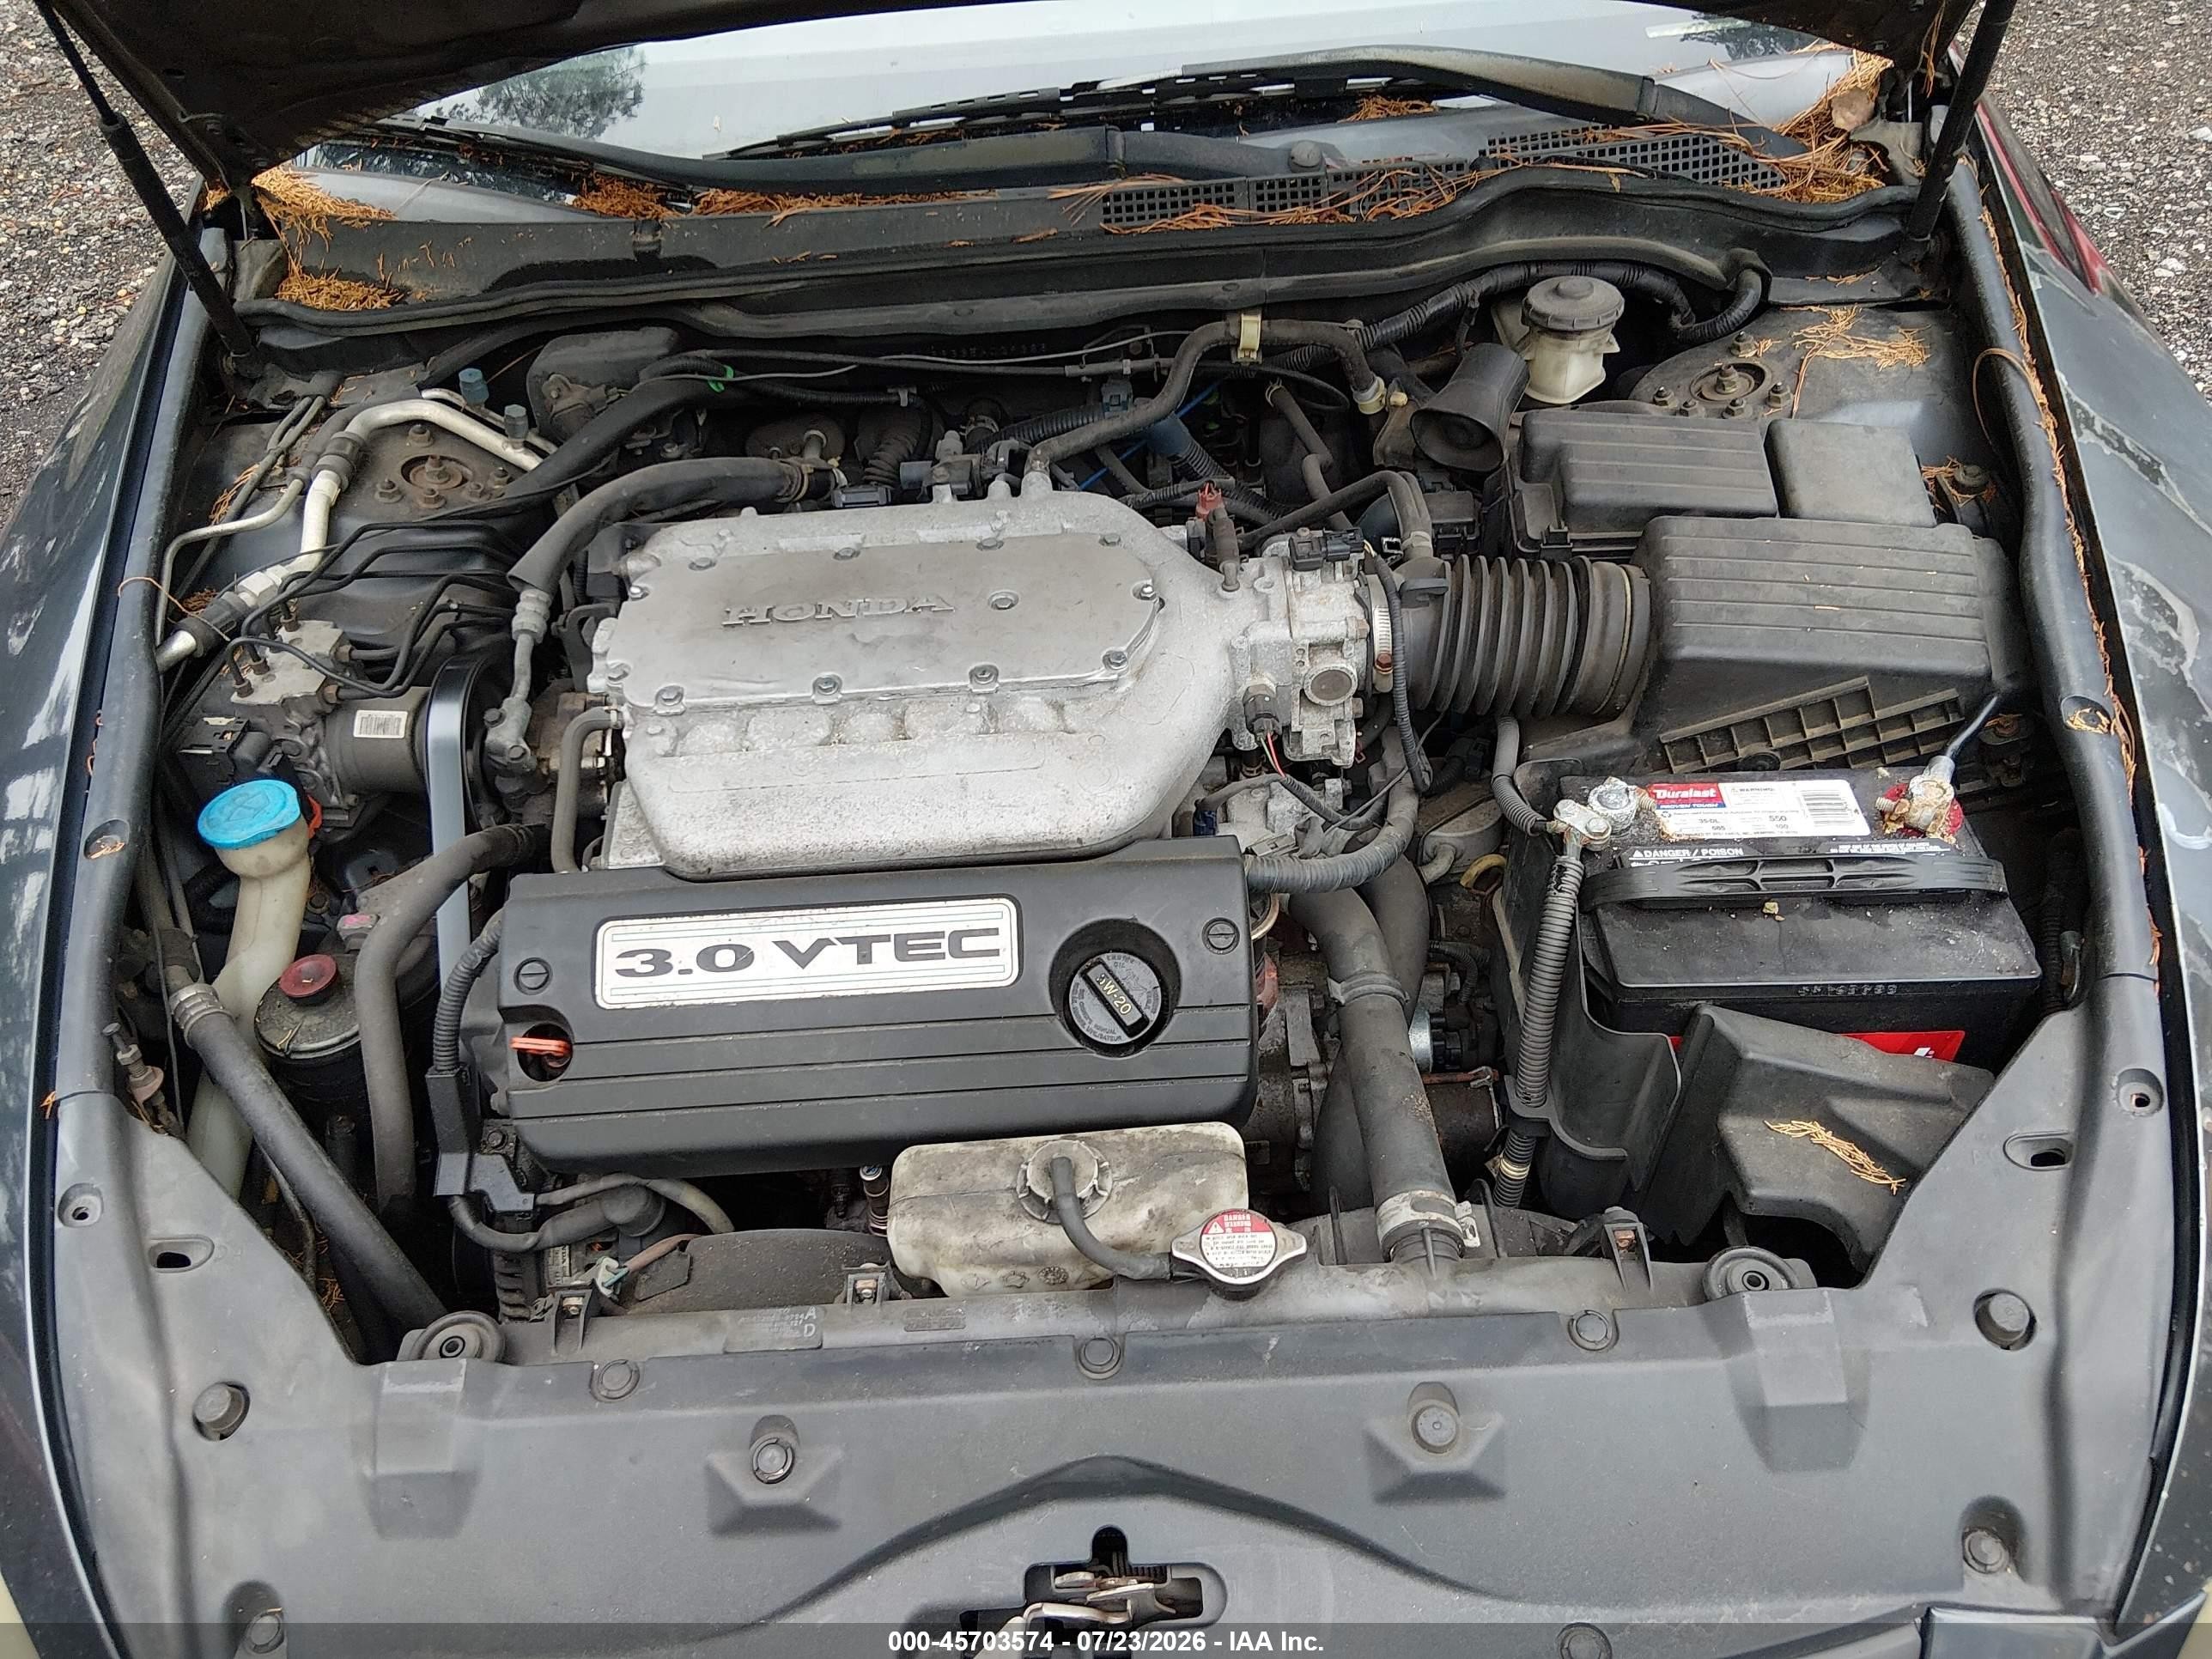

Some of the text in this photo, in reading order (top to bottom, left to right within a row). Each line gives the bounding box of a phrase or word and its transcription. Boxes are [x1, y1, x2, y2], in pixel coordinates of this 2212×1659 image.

[721, 593, 955, 626] HONDA
[1653, 787, 1717, 799] Duralast
[1644, 849, 1691, 858] DANGER
[1701, 848, 1744, 857] POISON
[616, 927, 1000, 978] 3.0 VTEC
